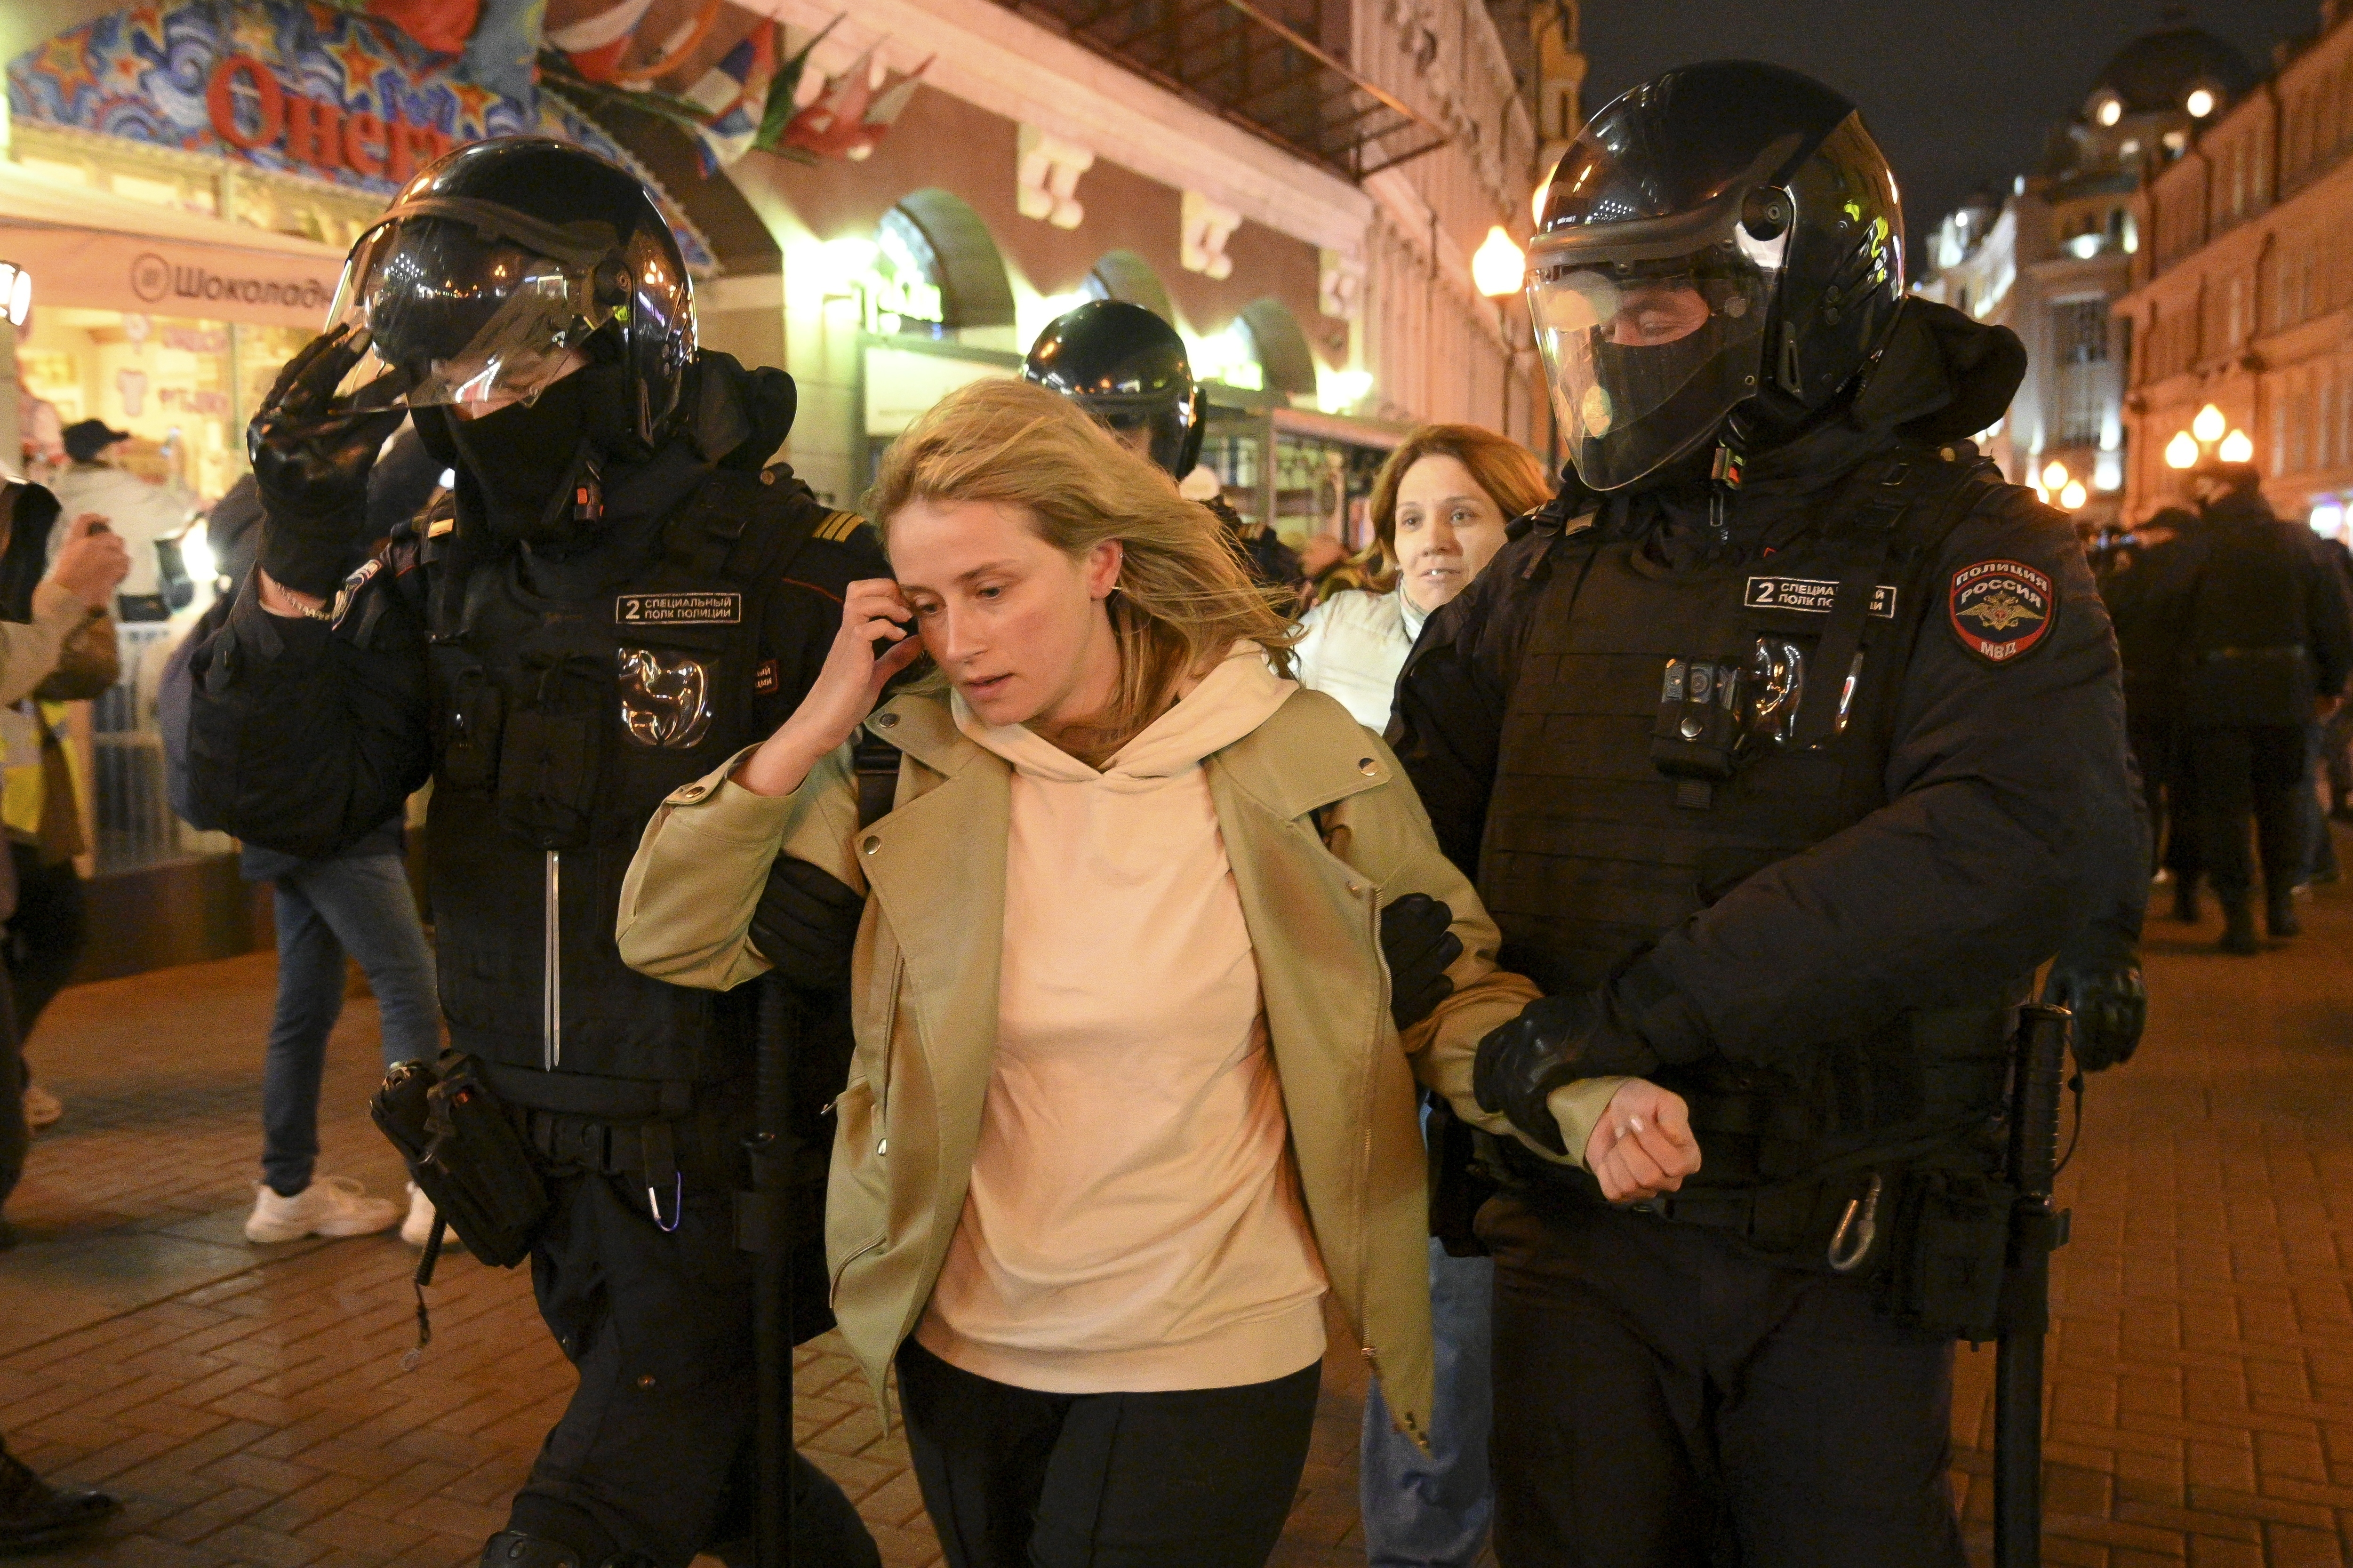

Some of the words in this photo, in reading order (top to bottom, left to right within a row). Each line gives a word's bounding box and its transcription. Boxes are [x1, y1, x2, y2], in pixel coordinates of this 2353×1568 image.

[1956, 564, 2047, 592] ПОЛИЦИЯ
[1755, 582, 1775, 602] 2
[1778, 594, 1815, 606] ПОЛК
[1961, 579, 2041, 608] РОССИЯ
[625, 600, 640, 619] 2
[644, 597, 732, 608] СПЕЦИАЛЬНЫЙ
[644, 609, 674, 619] ПОЛК
[677, 608, 731, 619] ПОЛИЦИИ
[1980, 640, 2017, 659] МВД
